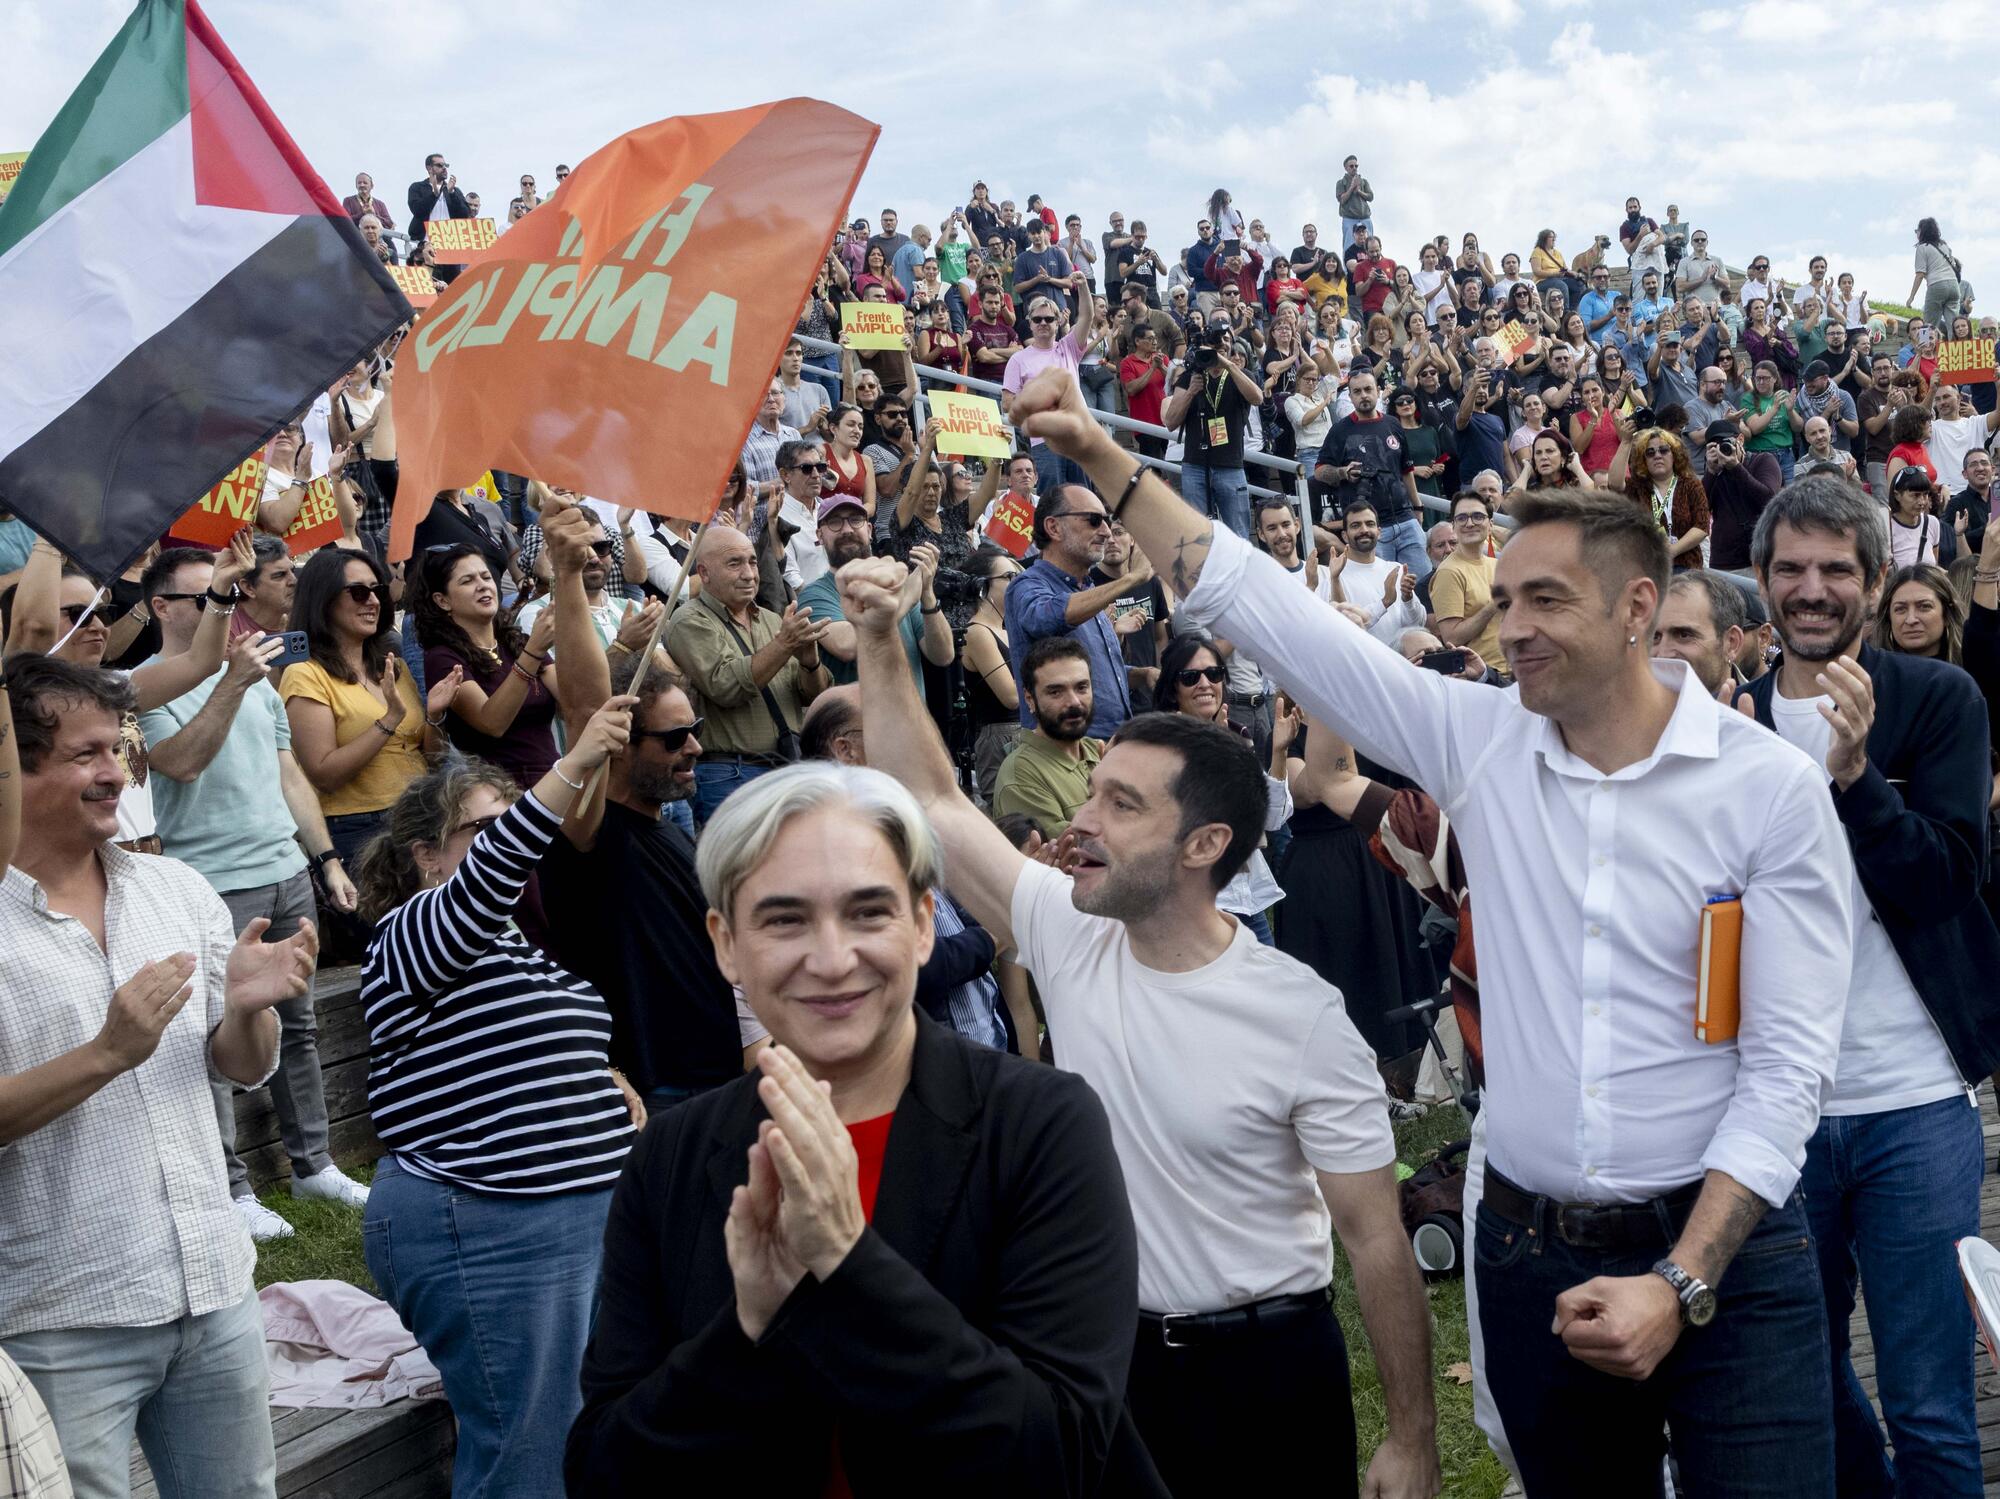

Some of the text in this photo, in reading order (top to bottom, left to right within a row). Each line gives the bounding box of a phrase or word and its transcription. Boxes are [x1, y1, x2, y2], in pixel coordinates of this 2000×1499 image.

[428, 218, 496, 237] AMPLIO
[857, 311, 892, 323] Frente
[844, 322, 905, 336] AMPLIO
[1938, 339, 1995, 358] AMPLIO
[948, 403, 989, 422] Frente
[994, 504, 1034, 543] CASA
